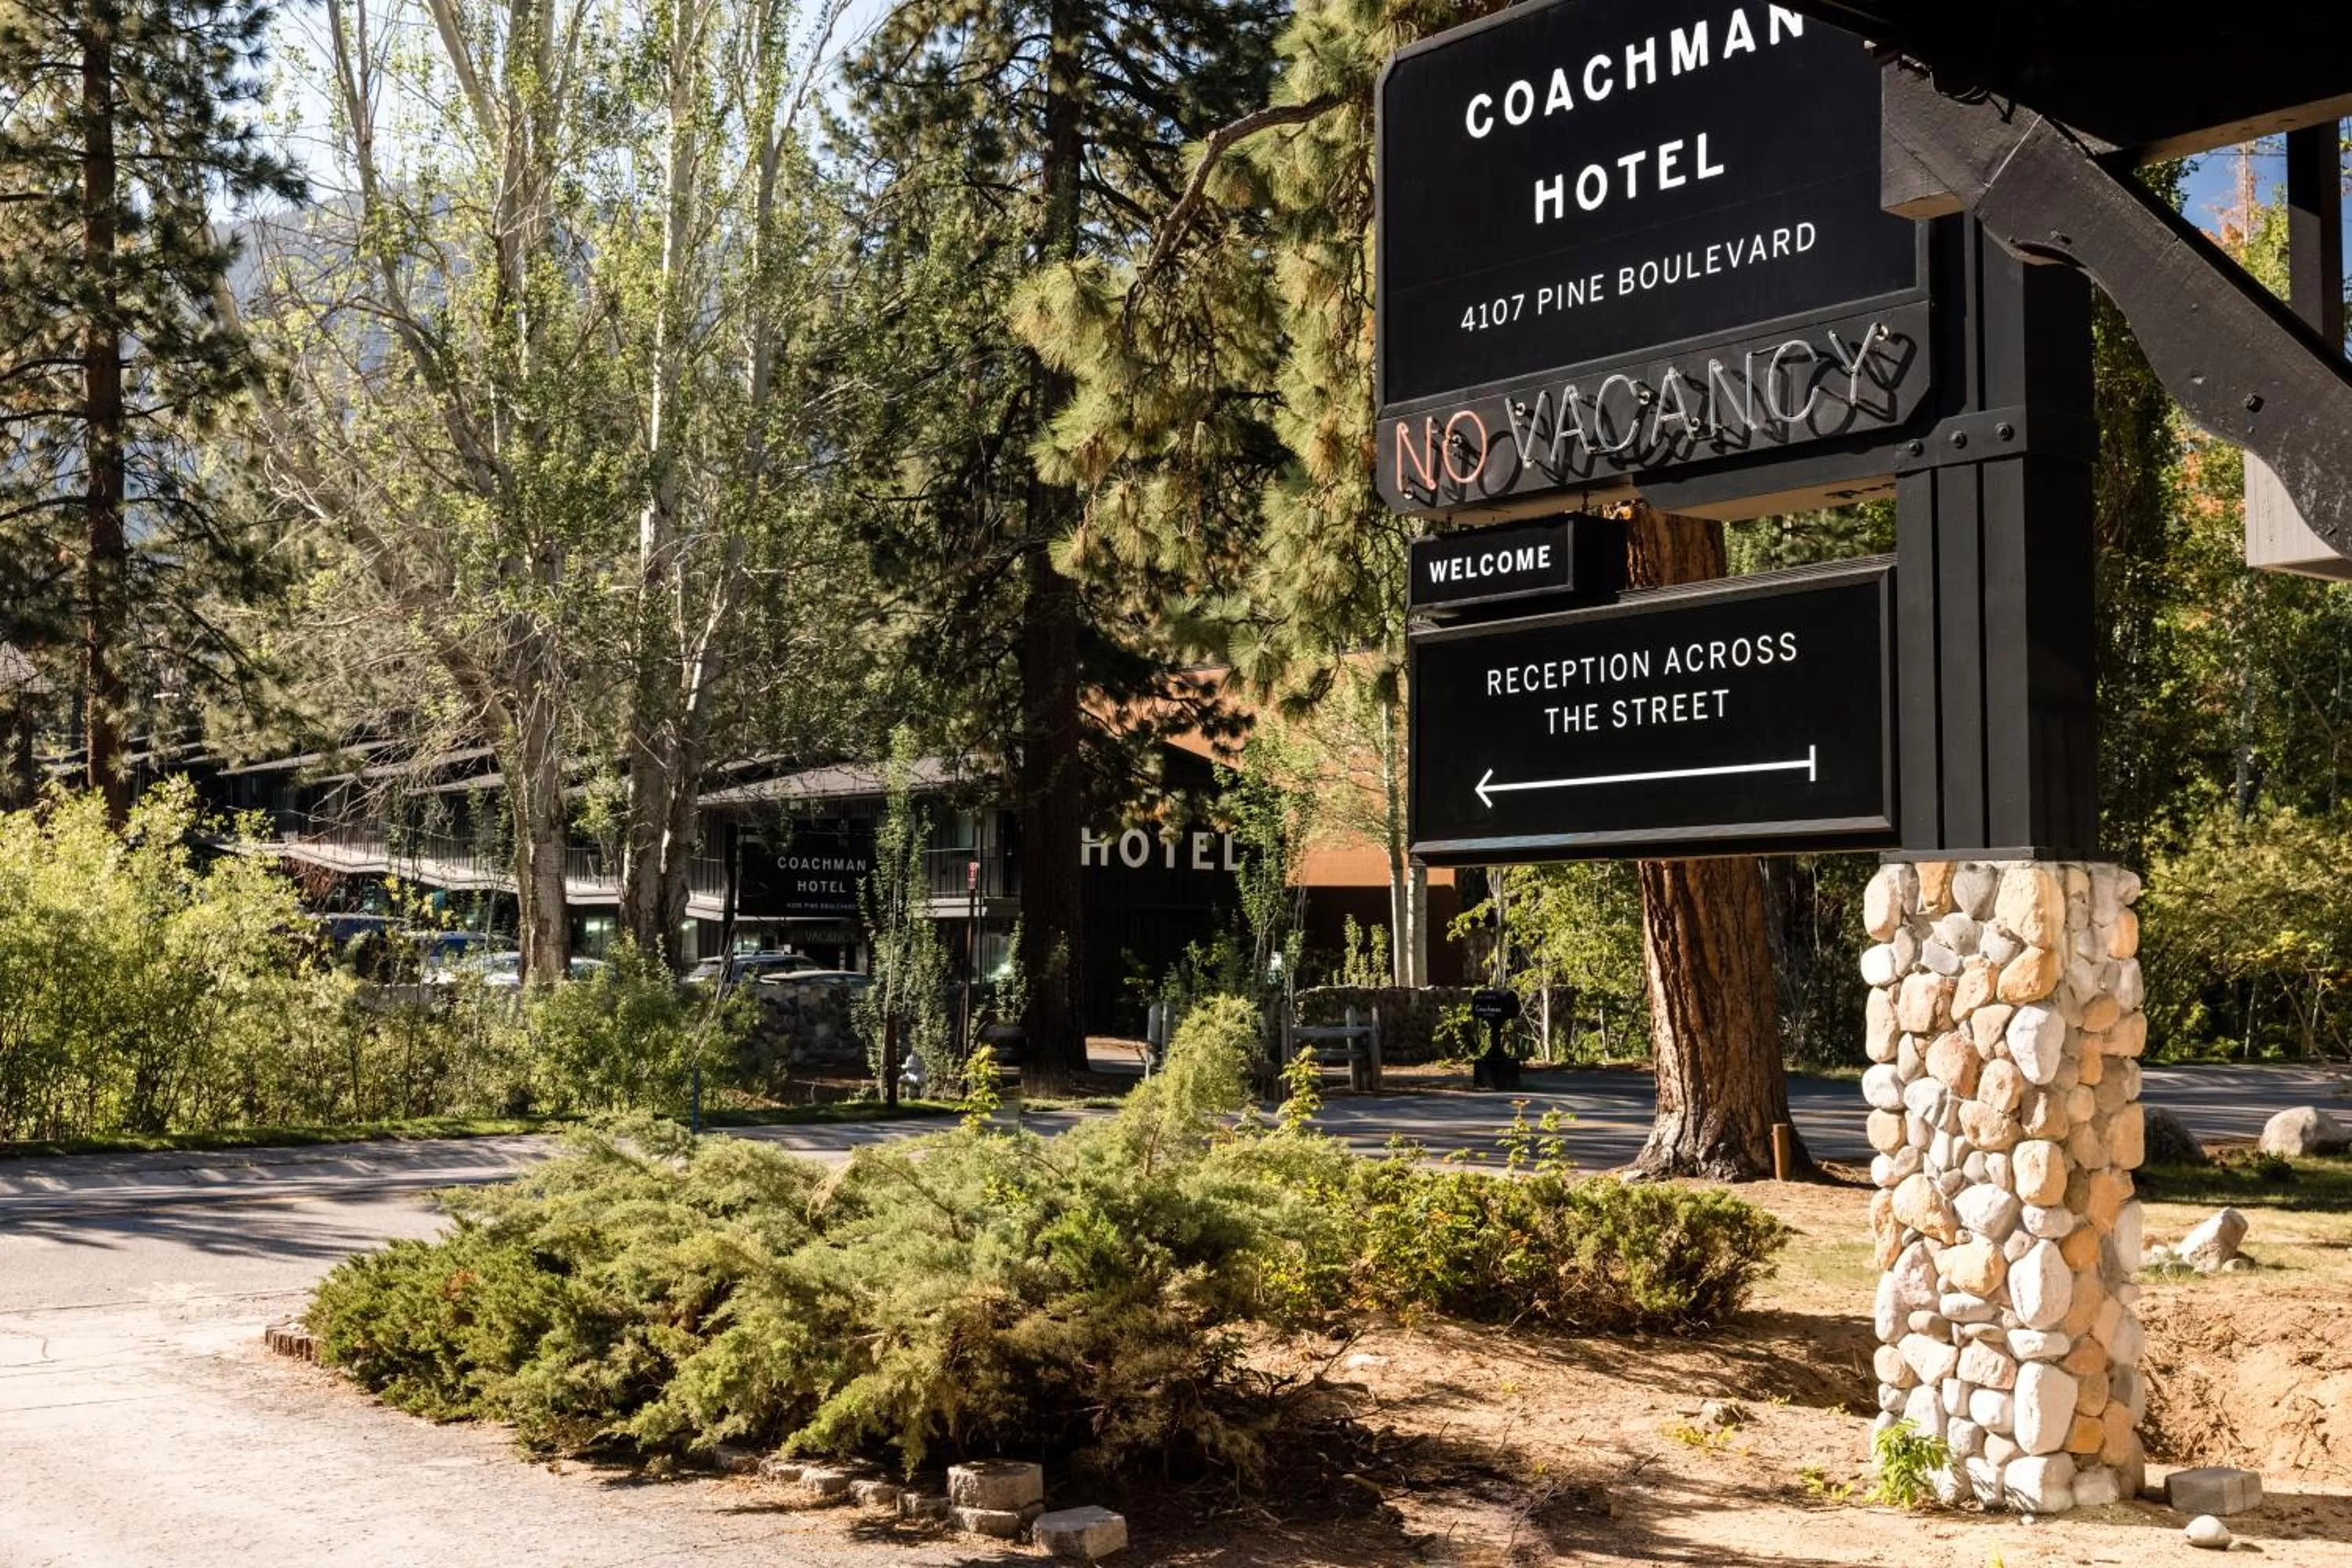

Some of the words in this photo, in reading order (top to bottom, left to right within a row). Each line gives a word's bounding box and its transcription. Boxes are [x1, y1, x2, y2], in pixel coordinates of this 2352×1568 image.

[1465, 3, 1804, 139] COACHMAN
[1534, 132, 1725, 224] HOTEL
[1461, 293, 1525, 332] 4107
[1537, 274, 1604, 315] PINE
[1618, 222, 1817, 296] BOULEVARD
[1396, 410, 1488, 492] NO
[1505, 322, 1883, 468] VACANCY
[1429, 545, 1552, 583] WELCOME
[1487, 650, 1650, 696] RECEPTION
[1664, 632, 1798, 675] ACROSS
[1544, 703, 1599, 735] THE
[1612, 689, 1730, 728] STREET
[777, 855, 866, 871] COACHMAN
[1081, 827, 1240, 871] HOTEL
[797, 880, 848, 894] HOTEL
